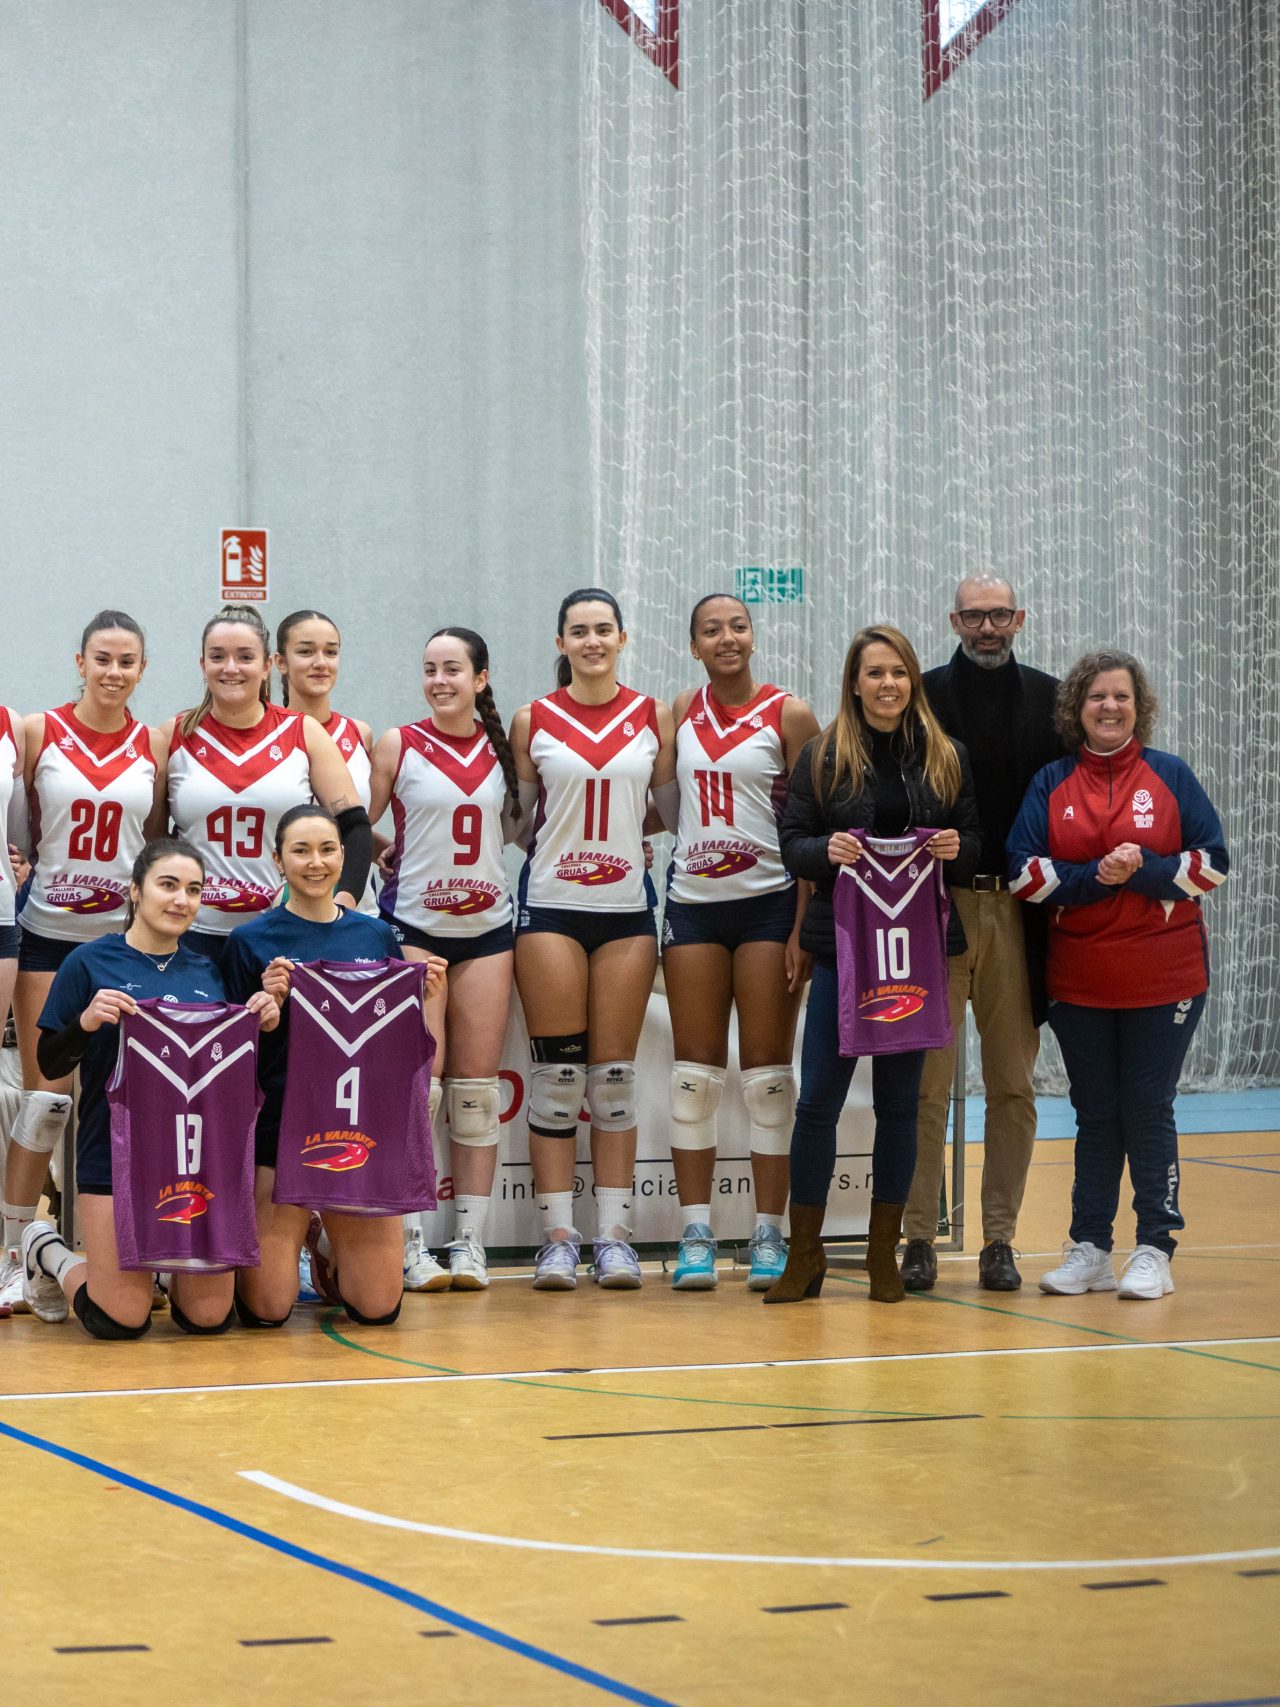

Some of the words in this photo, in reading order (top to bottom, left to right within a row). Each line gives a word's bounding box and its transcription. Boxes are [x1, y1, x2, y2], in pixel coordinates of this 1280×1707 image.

[223, 591, 264, 599] EXTINTOR
[694, 769, 735, 827] 14
[583, 779, 611, 841] 11
[68, 798, 124, 862] 20
[206, 805, 266, 858] 43
[452, 803, 483, 866] 9
[688, 842, 699, 855] LA
[701, 840, 766, 858] VARIANTE
[556, 866, 588, 877] GRUAS
[560, 852, 574, 862] LA
[578, 852, 633, 872] VARIANTE
[686, 857, 714, 872] GRUAS
[51, 873, 68, 885] LA
[426, 879, 443, 891] LA
[447, 878, 503, 898] VARIANTE
[46, 891, 82, 902] GRUAS
[200, 891, 227, 900] RUAS
[423, 895, 459, 906] GRUAS
[876, 927, 910, 981] 10
[336, 1067, 360, 1126] 4
[175, 1113, 203, 1175] 13
[305, 1133, 320, 1146] LA
